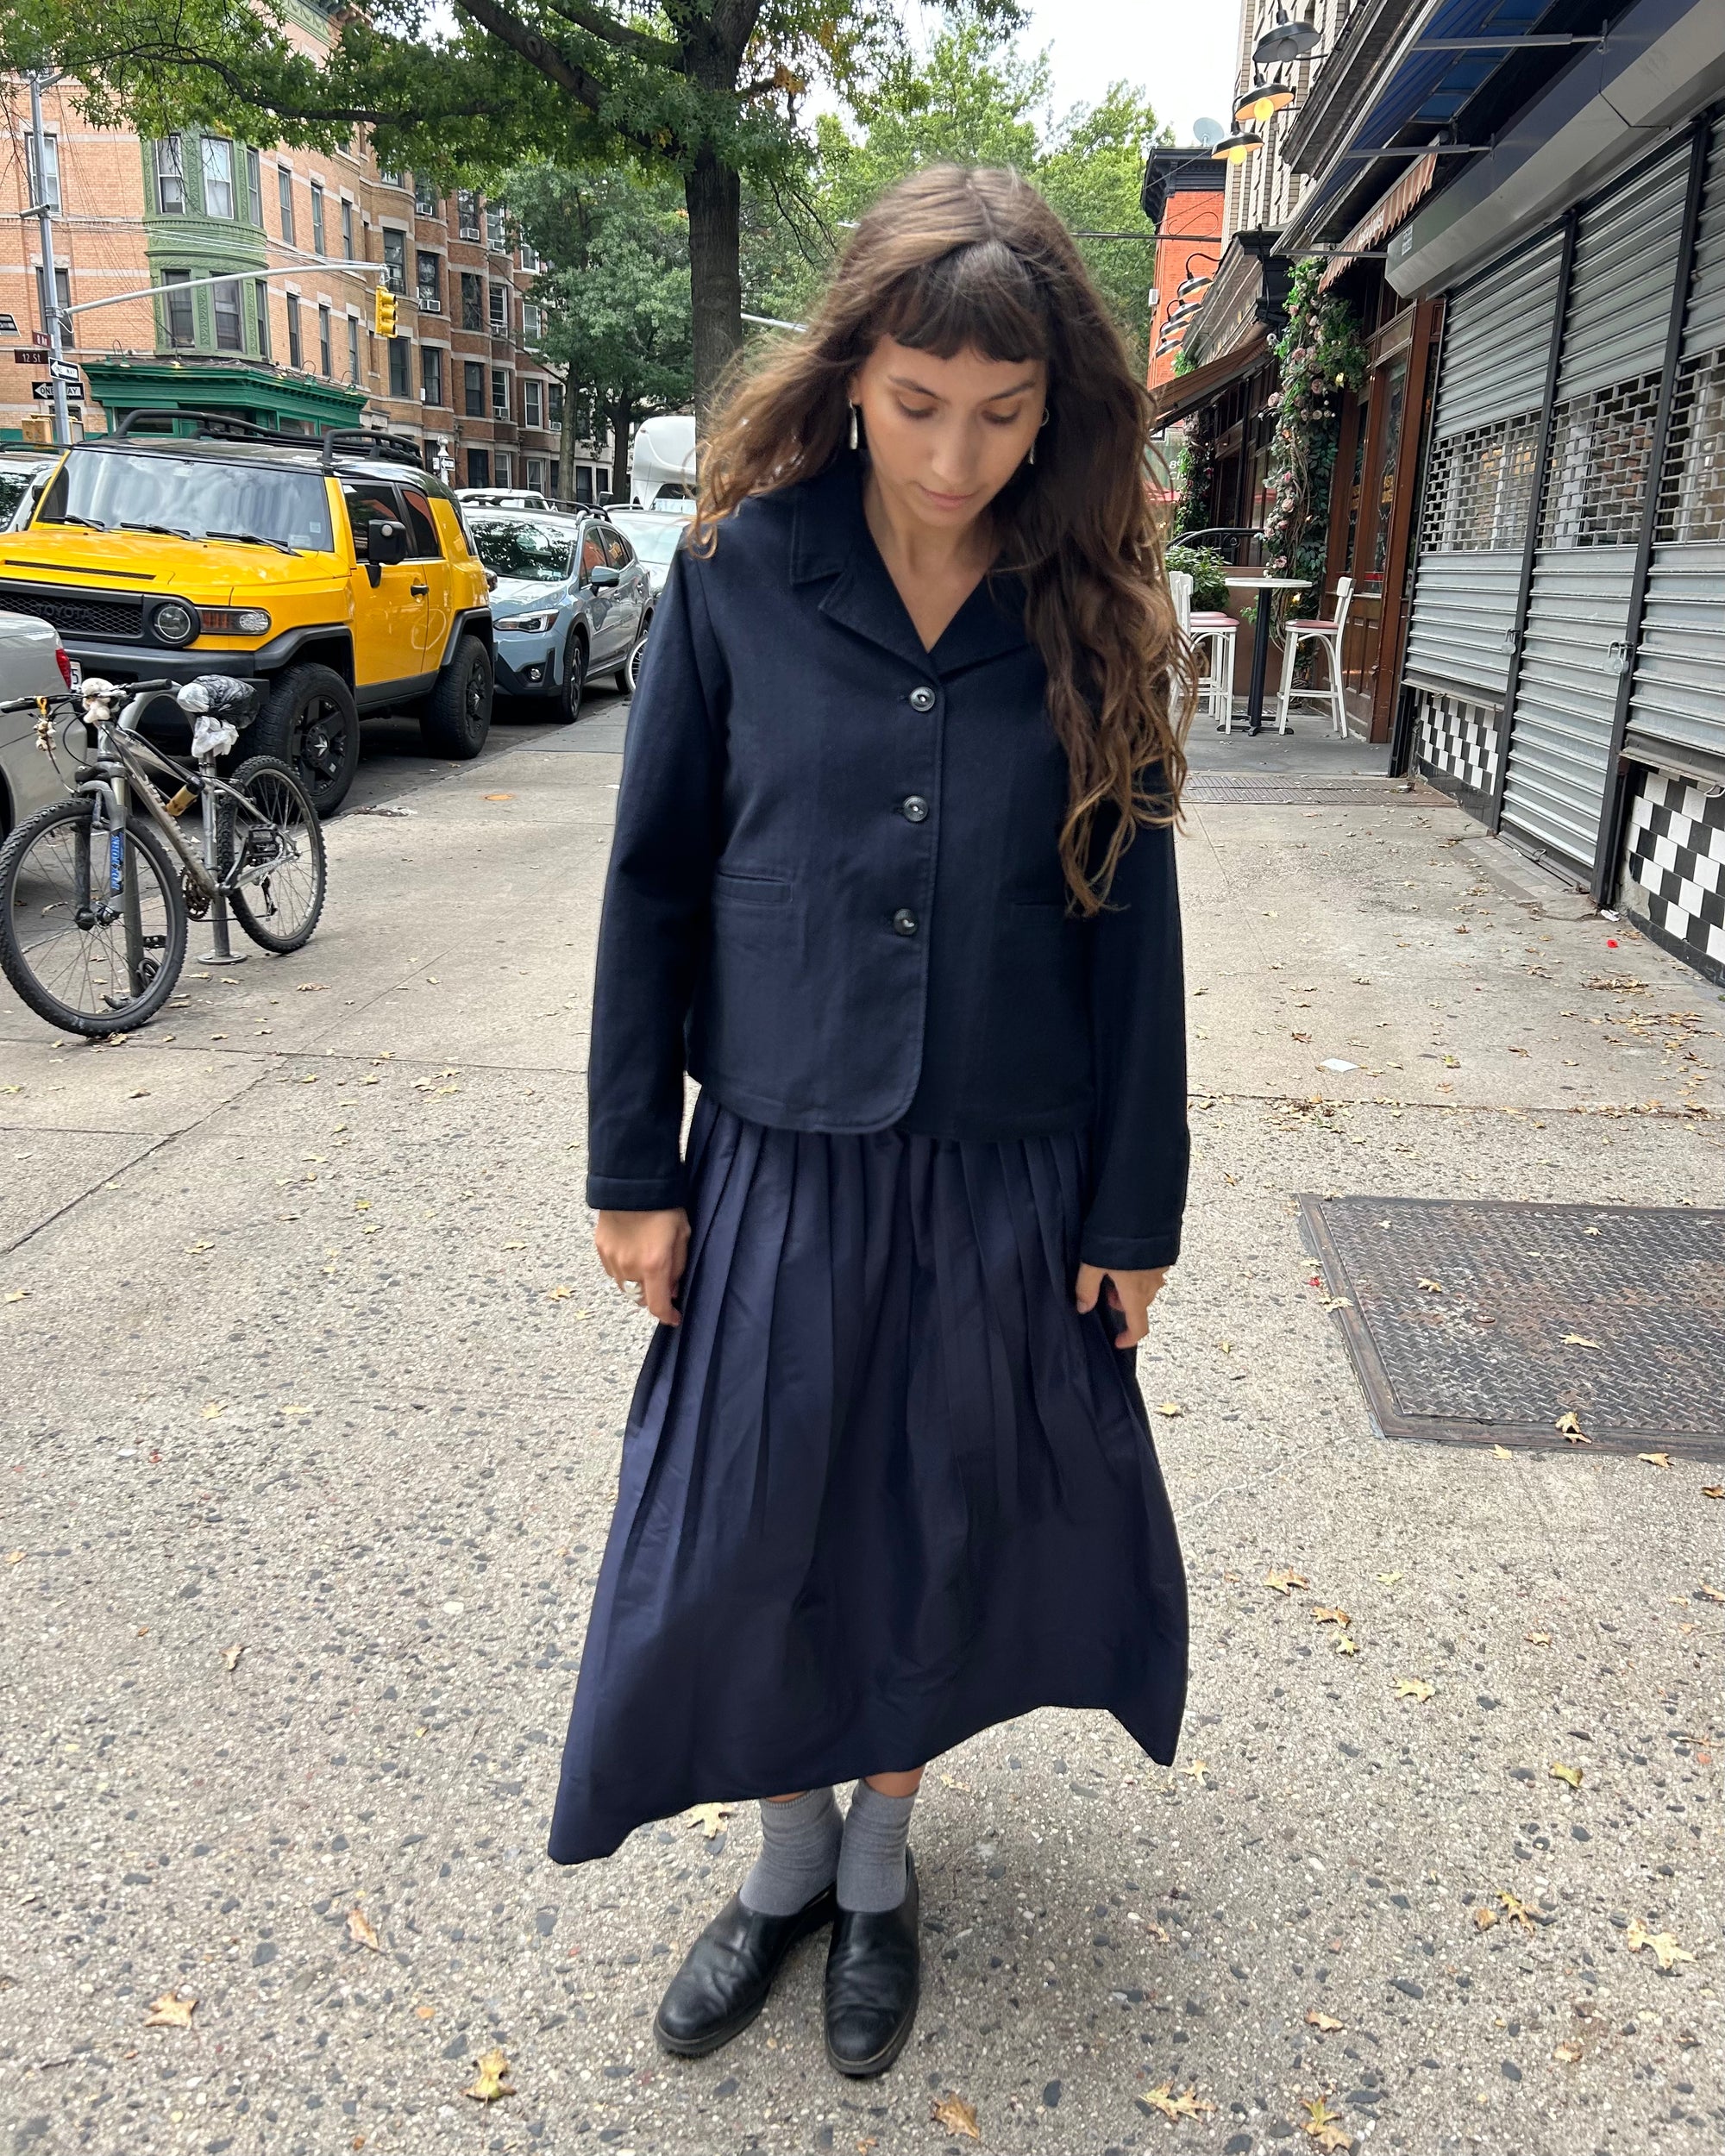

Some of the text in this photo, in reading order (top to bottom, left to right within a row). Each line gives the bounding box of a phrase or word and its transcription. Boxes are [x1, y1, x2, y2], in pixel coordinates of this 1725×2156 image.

[22, 354, 41, 363] 12 St
[36, 603, 93, 620] TOYOTA
